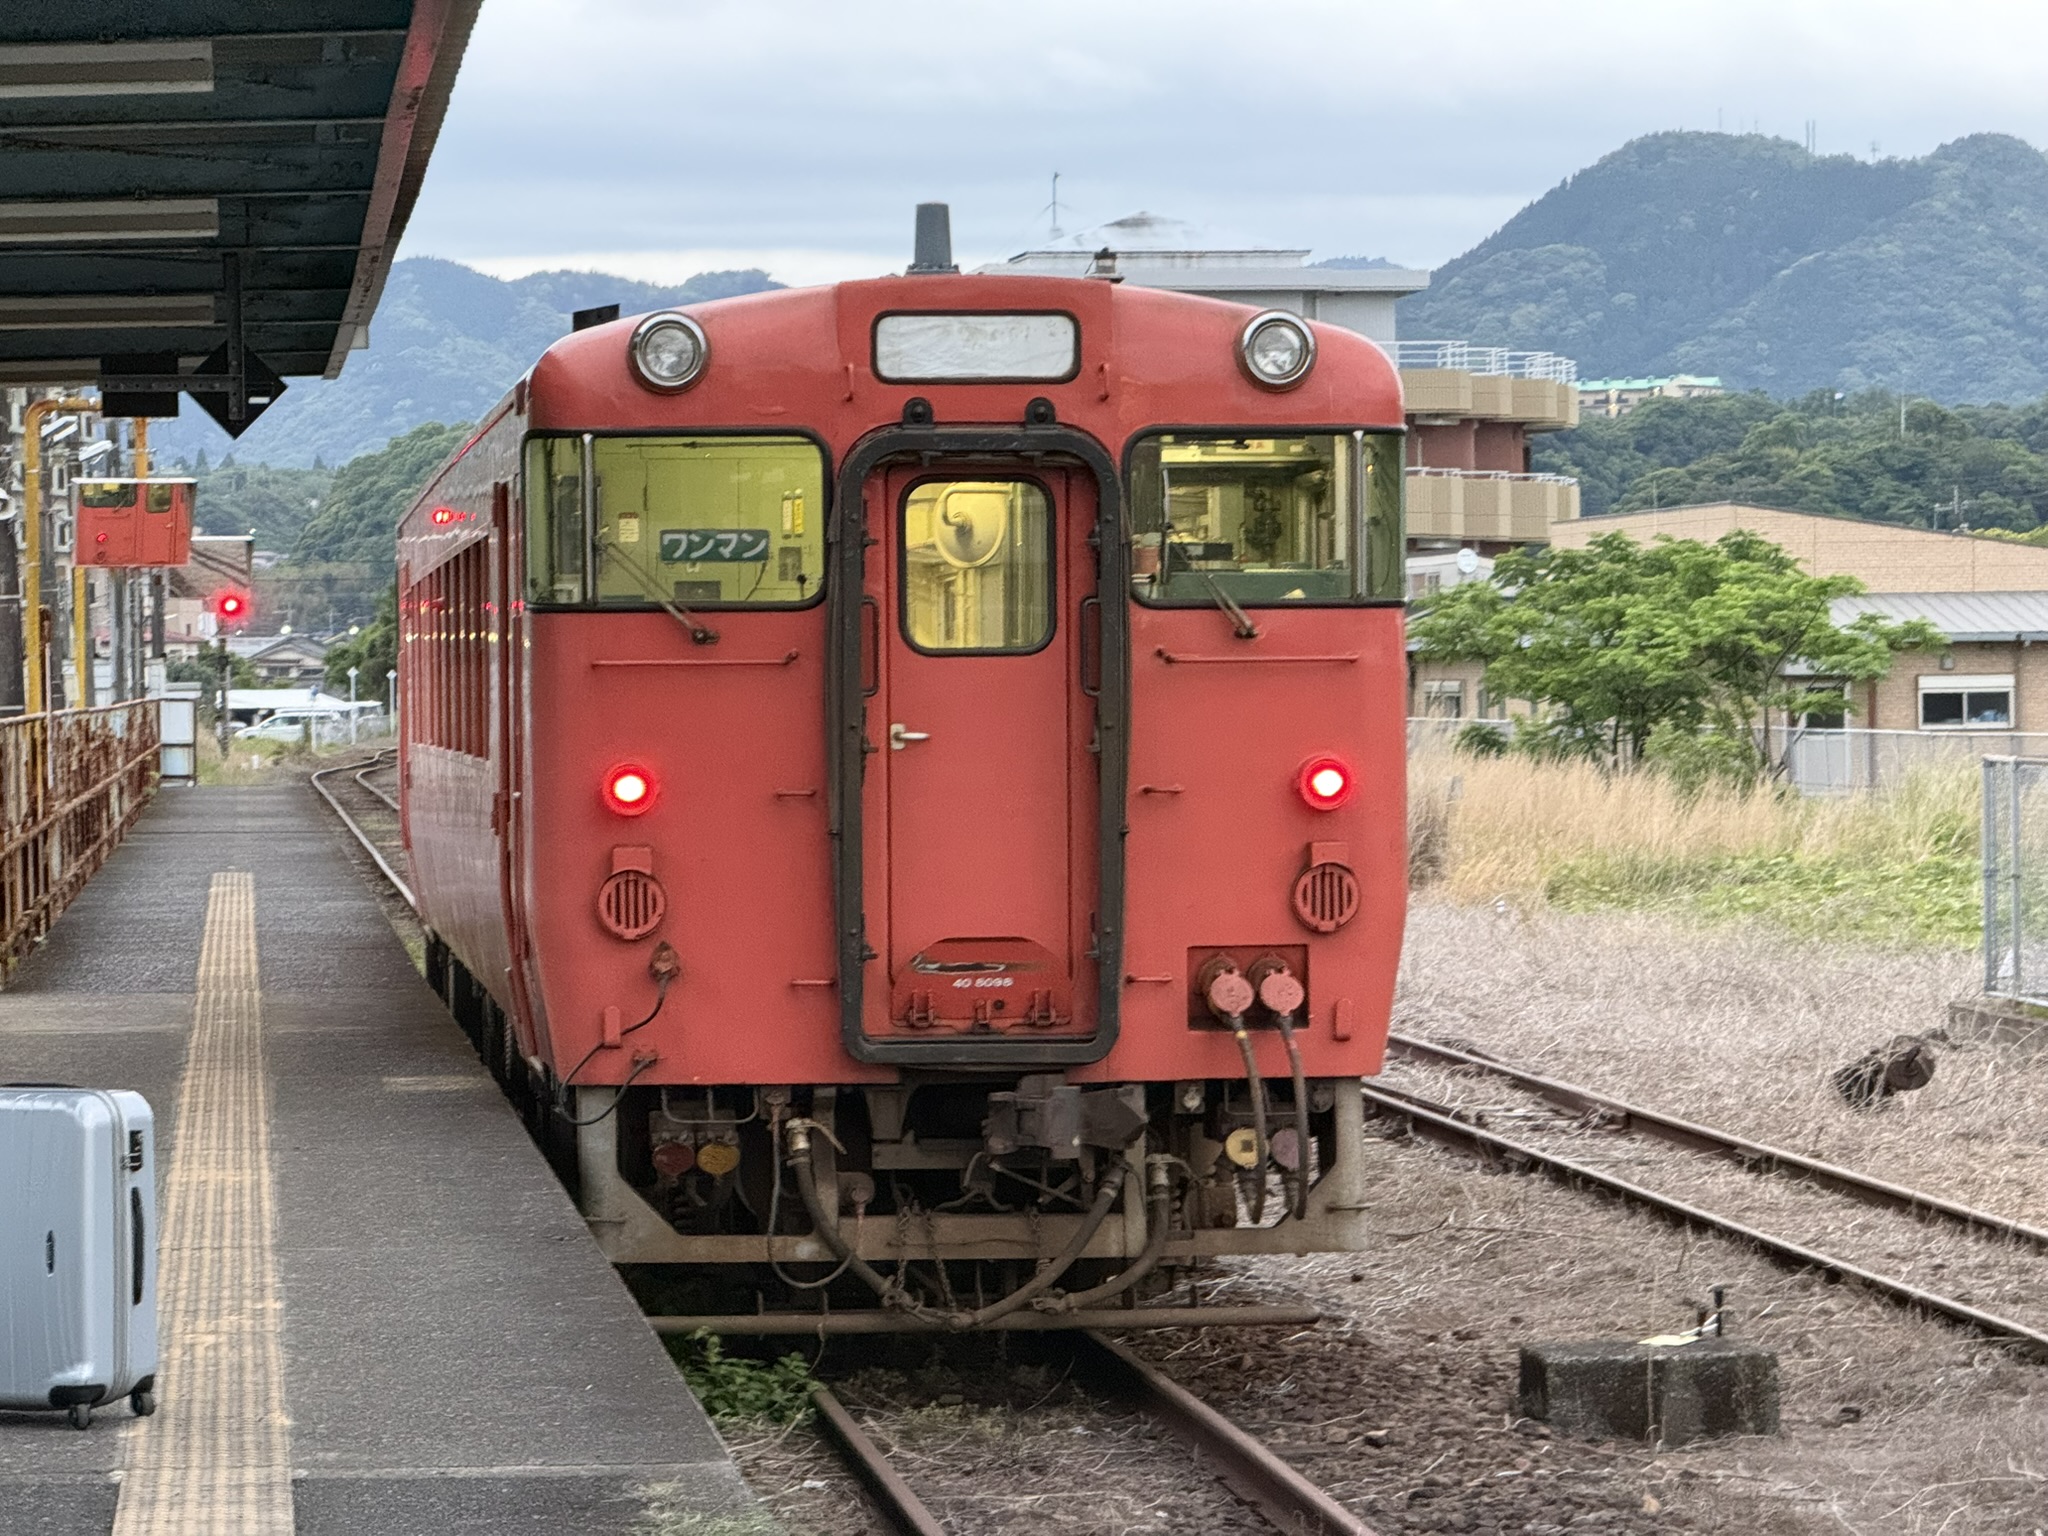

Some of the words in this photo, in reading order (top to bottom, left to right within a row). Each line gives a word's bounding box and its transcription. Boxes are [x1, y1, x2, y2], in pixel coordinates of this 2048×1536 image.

[662, 533, 767, 558] ワンマン
[952, 977, 972, 988] 40
